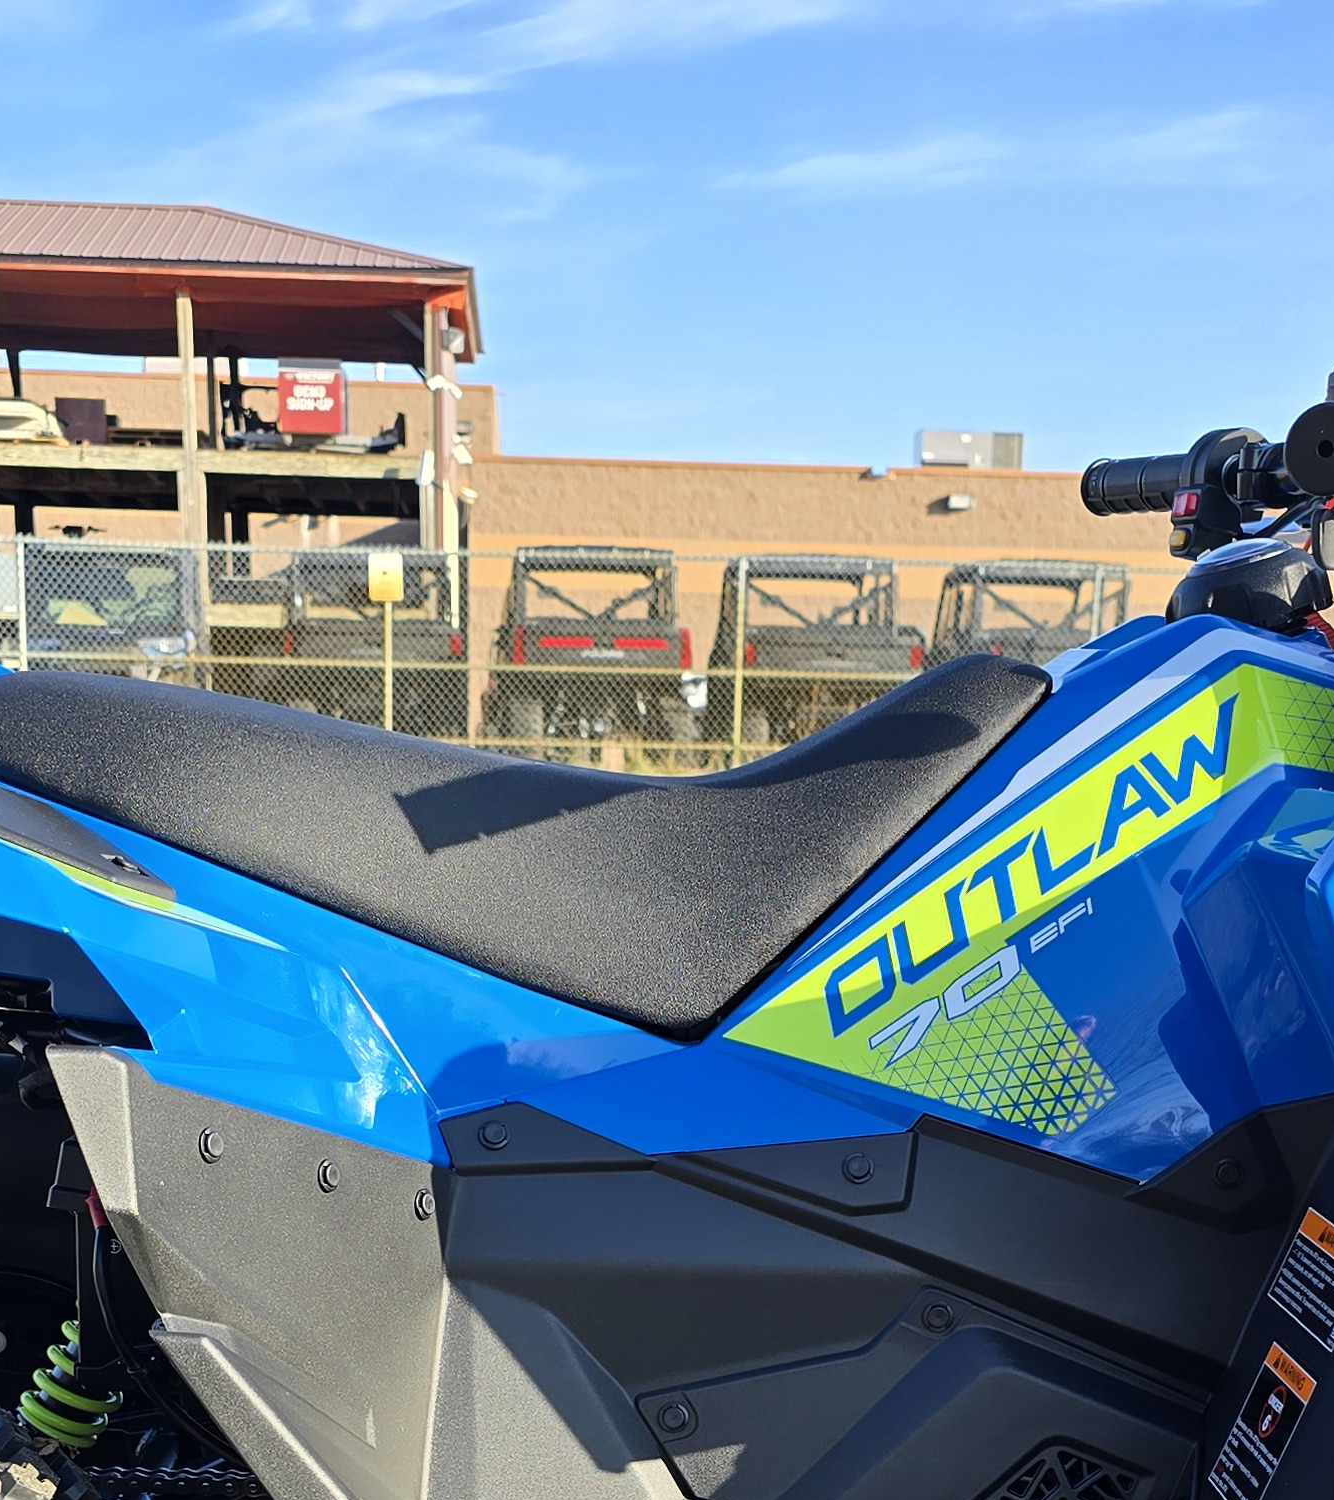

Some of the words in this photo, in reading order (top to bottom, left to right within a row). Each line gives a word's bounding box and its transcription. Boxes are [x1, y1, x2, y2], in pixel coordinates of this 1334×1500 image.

[824, 692, 1240, 1038] OUTLAW
[867, 944, 1023, 1070] 70
[1029, 897, 1094, 954] EFI
[1261, 1414, 1272, 1431] 6
[1280, 1358, 1306, 1391] WARNING
